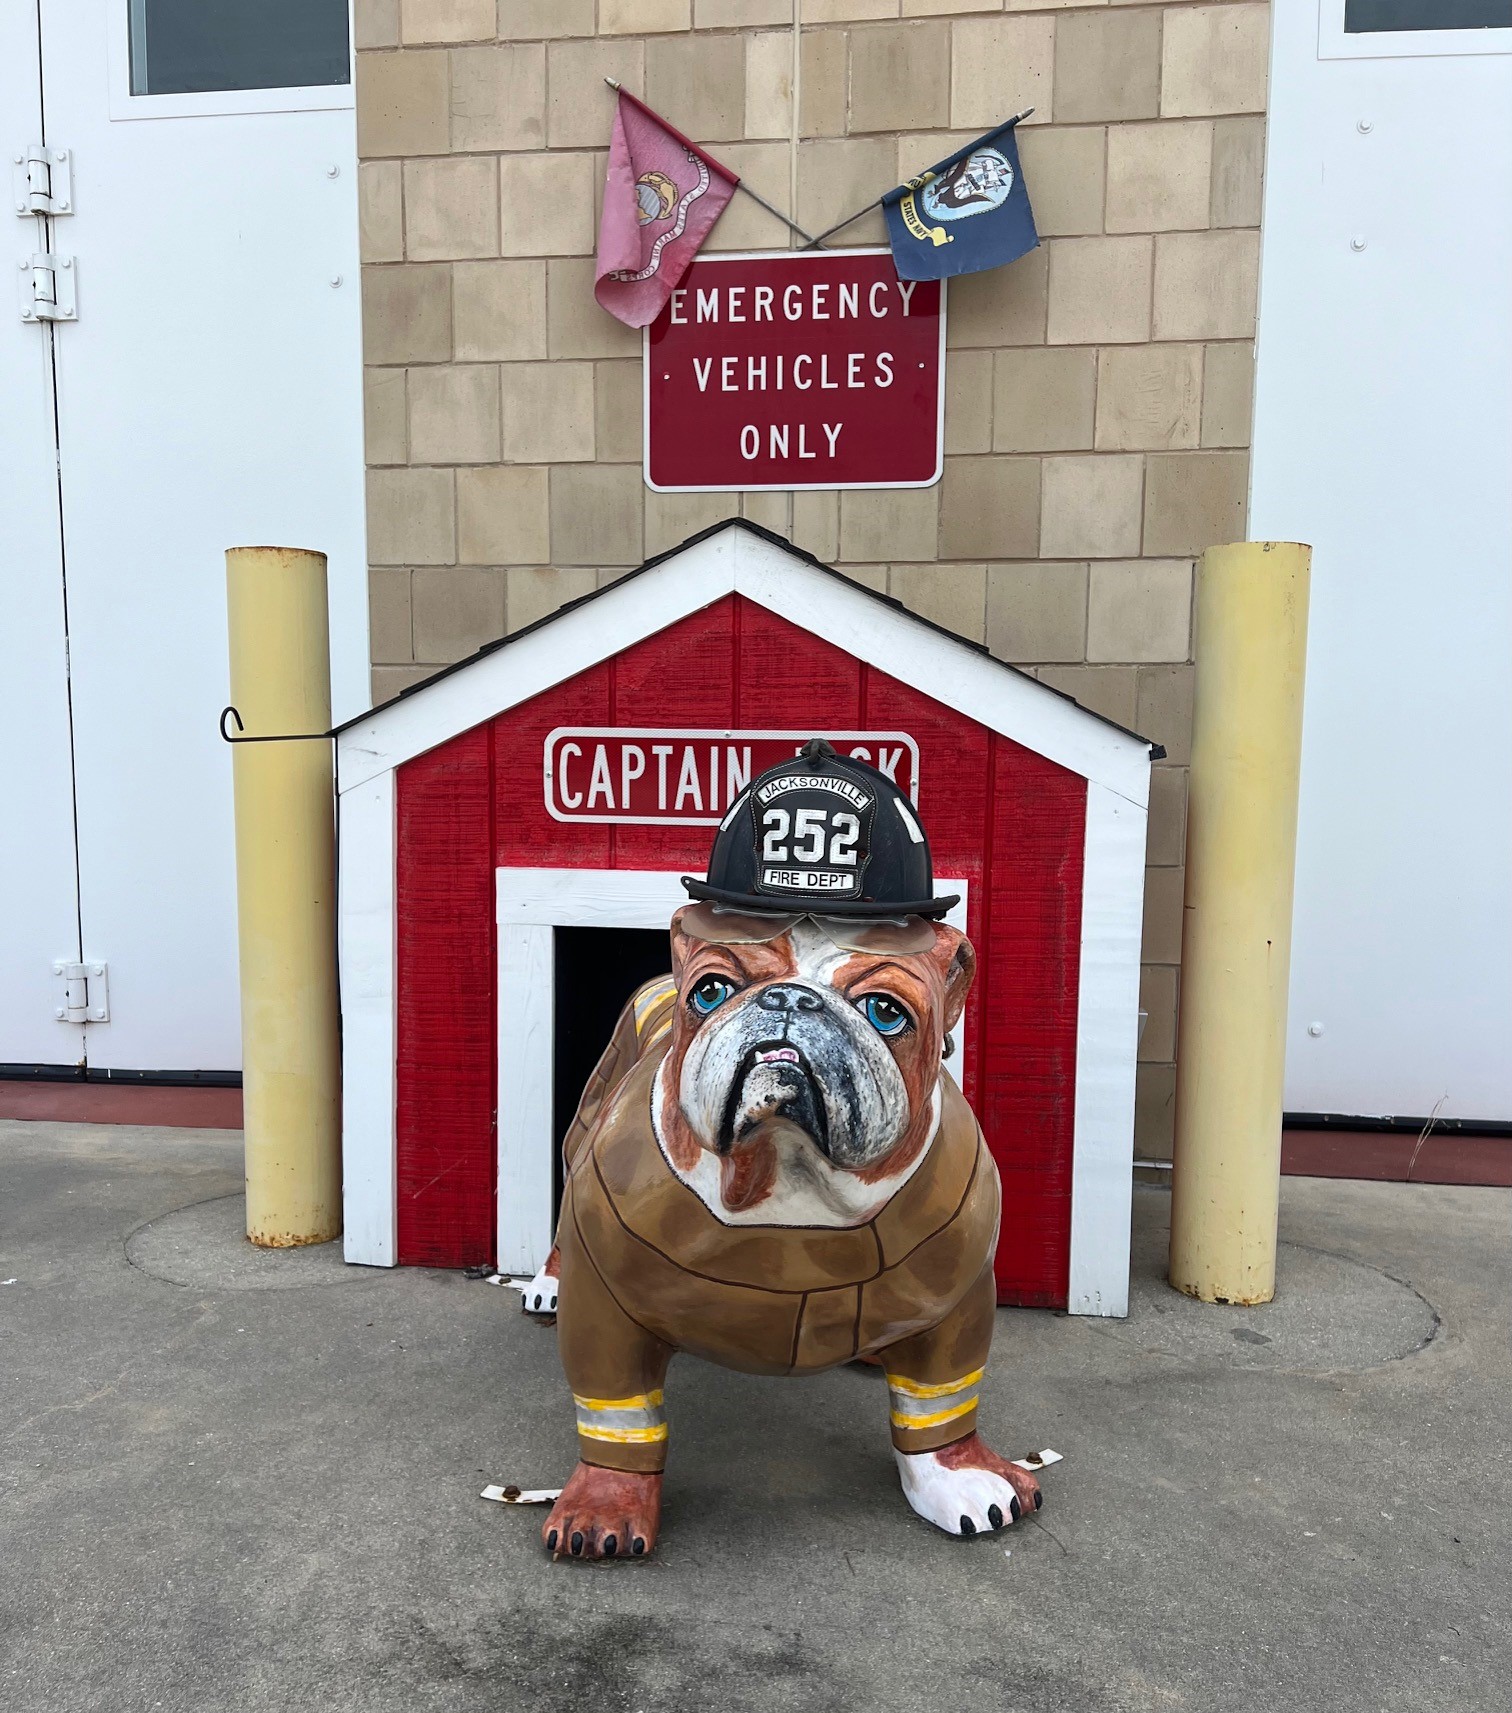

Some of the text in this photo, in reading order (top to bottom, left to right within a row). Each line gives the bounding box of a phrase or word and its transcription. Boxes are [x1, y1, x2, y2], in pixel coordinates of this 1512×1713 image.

[903, 201, 917, 226] STATES
[670, 281, 917, 324] EMERGENCY
[692, 352, 895, 392] VEHICLES
[740, 423, 843, 460] ONLY
[559, 743, 751, 811] CAPTAIN
[764, 777, 866, 806] JACKSONVILLE
[763, 808, 860, 865] 252
[770, 870, 847, 888] FIRE DEPT
